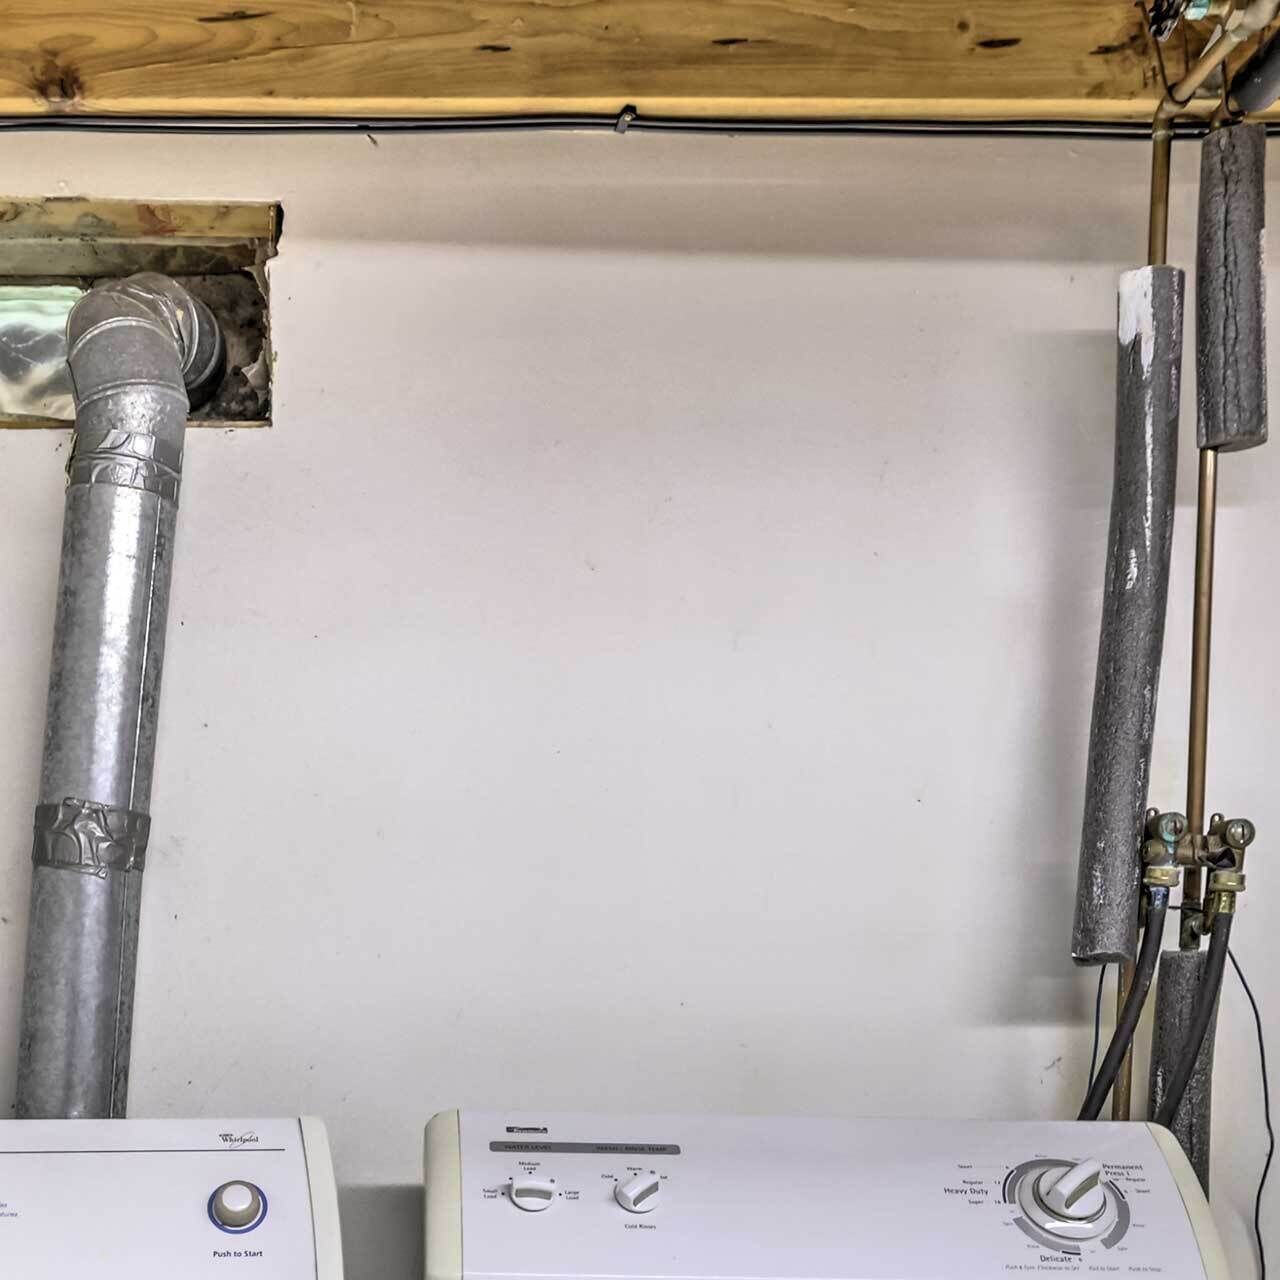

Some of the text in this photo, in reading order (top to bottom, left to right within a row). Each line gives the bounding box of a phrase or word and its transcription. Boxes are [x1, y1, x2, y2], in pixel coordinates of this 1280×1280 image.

[222, 1135, 259, 1144] Whirlpool
[1102, 1163, 1143, 1171] Permanent
[944, 1188, 988, 1196] Heavy Duty
[1040, 1255, 1072, 1263] Delicate
